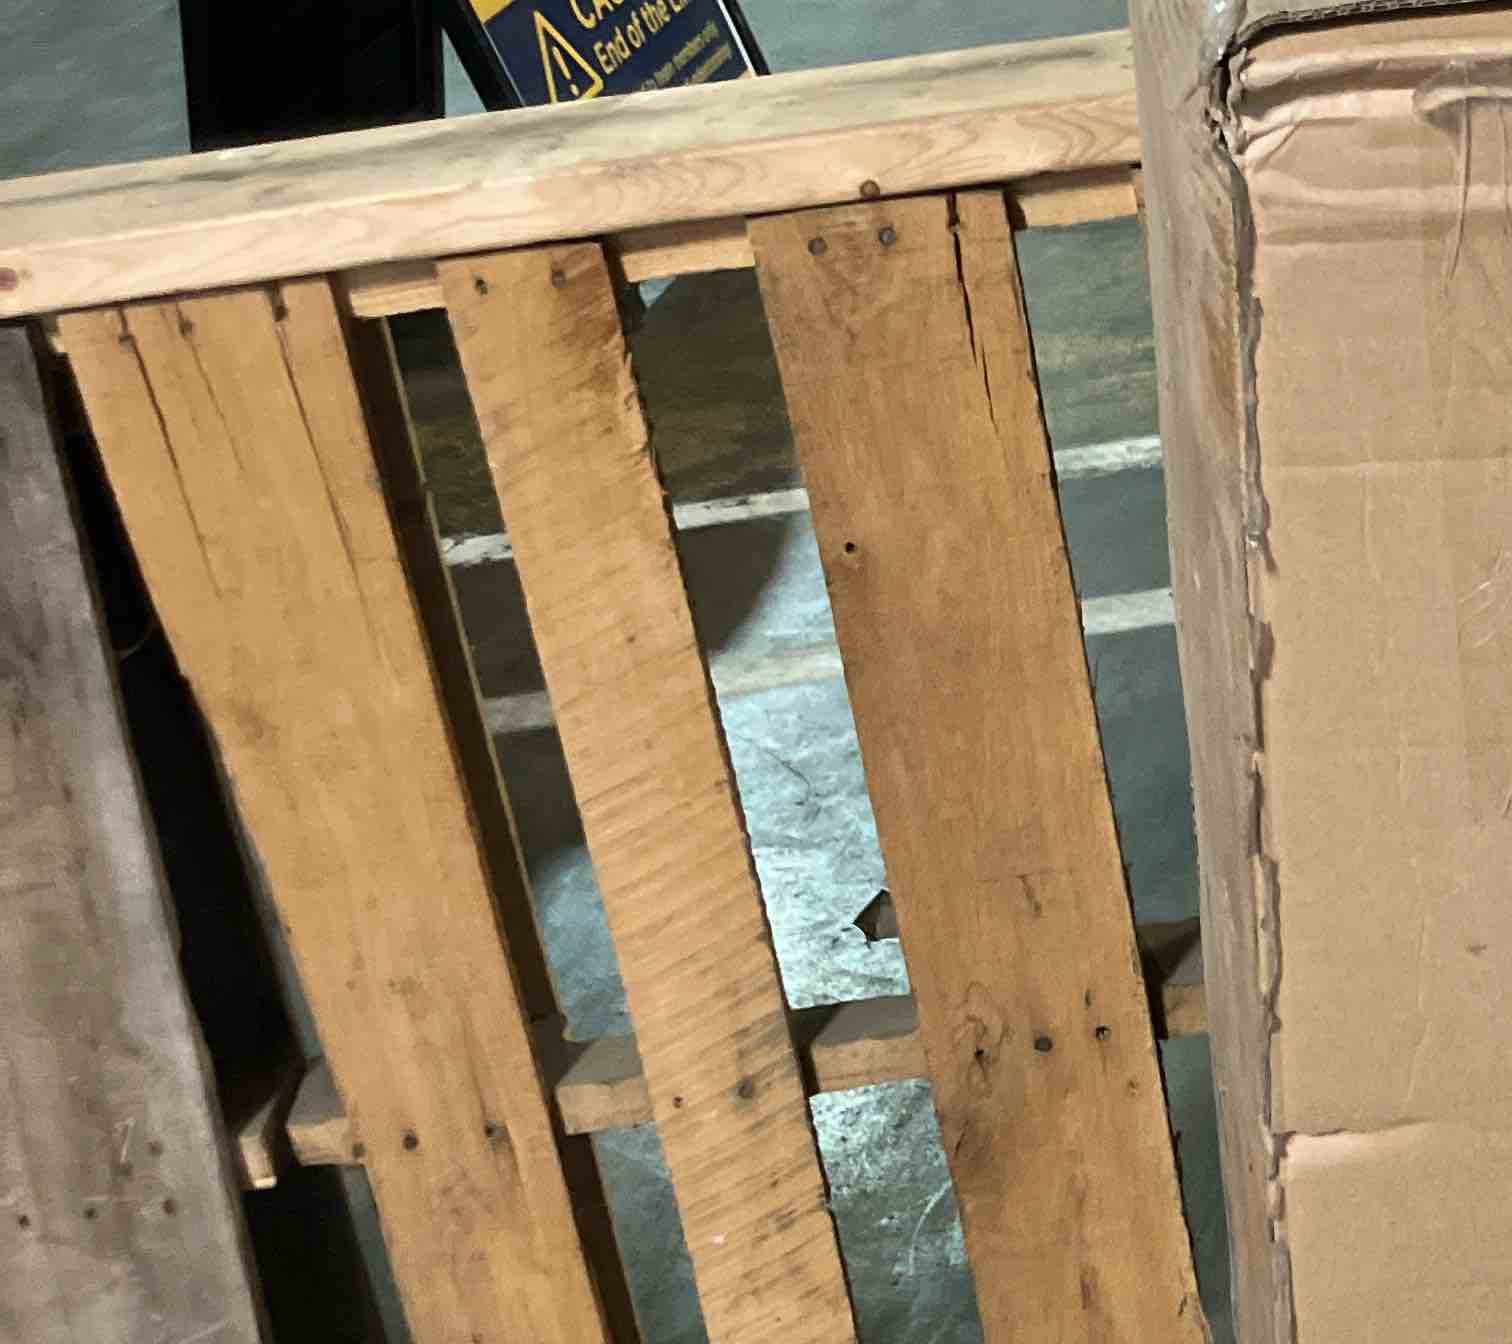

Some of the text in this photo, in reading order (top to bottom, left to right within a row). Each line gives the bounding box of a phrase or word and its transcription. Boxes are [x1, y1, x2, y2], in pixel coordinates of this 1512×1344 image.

[592, 25, 632, 76] End
[625, 9, 646, 49] of
[639, 1, 671, 34] the
